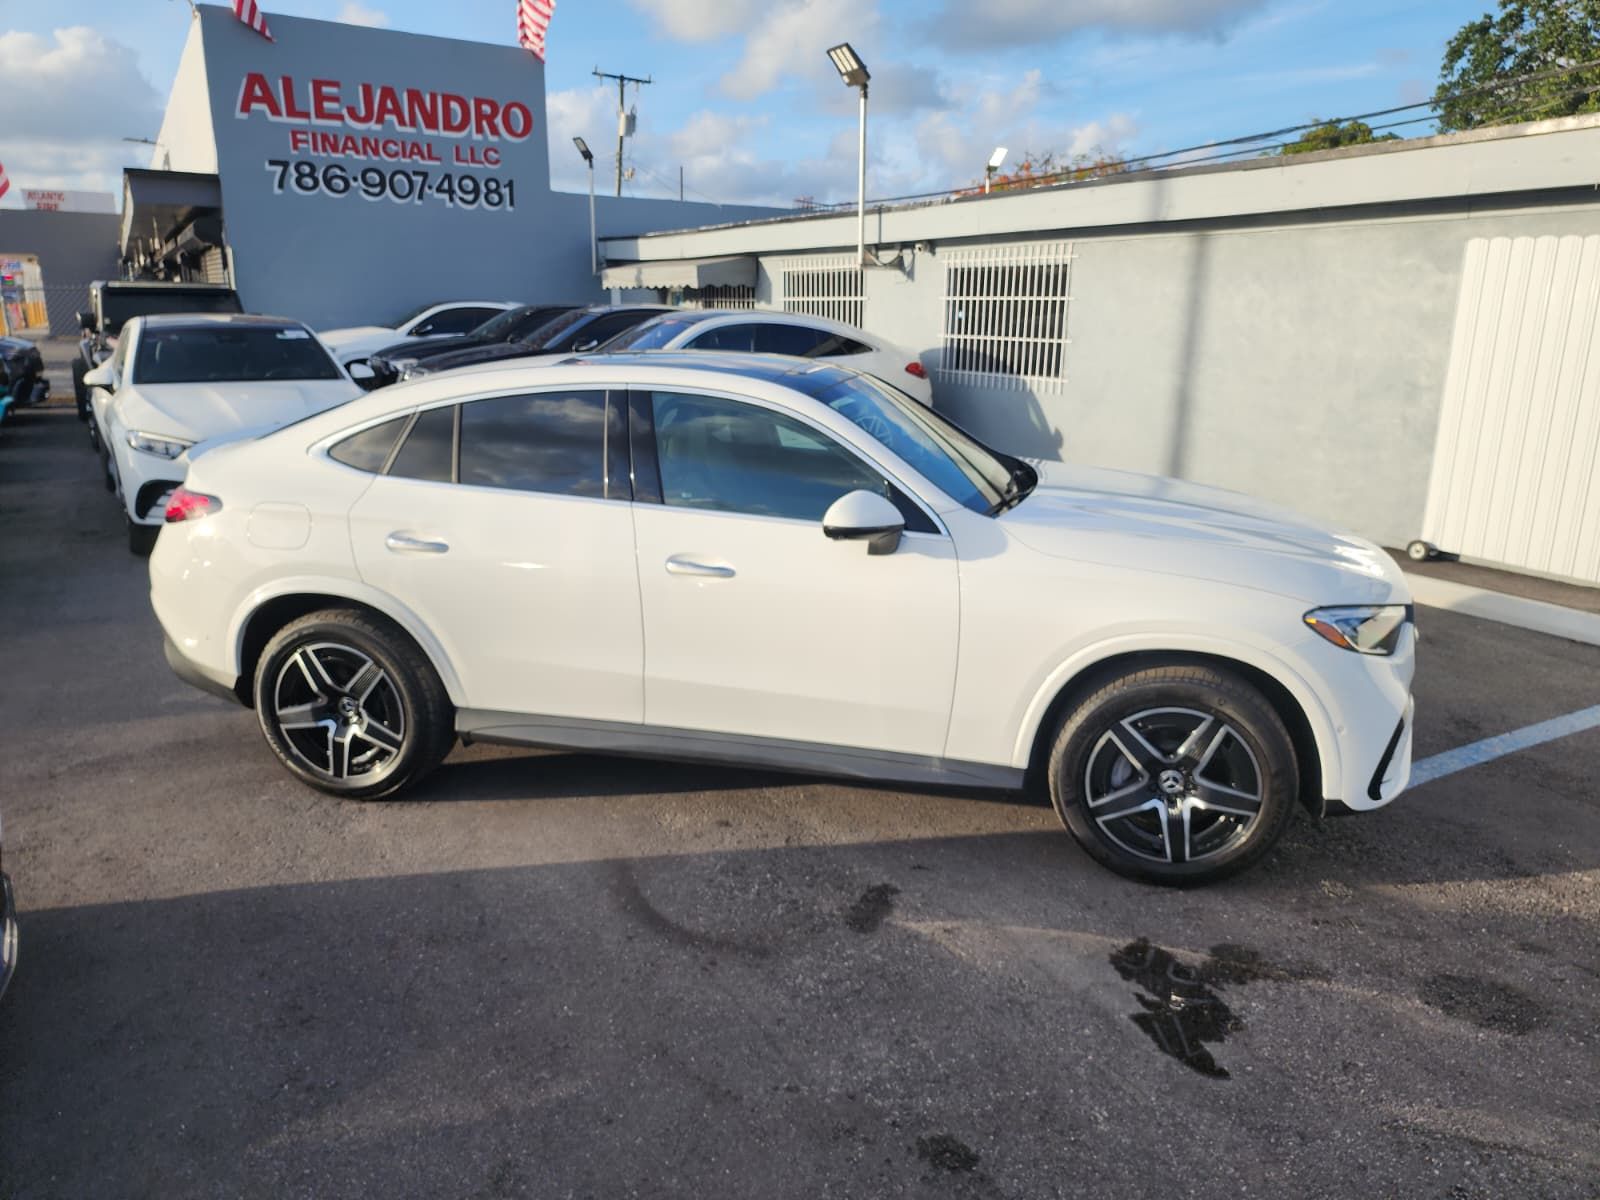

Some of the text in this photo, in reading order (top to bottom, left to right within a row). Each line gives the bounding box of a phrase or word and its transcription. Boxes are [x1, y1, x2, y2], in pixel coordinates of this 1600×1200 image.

[235, 72, 533, 142] ALEJANDRO
[289, 130, 502, 168] FINANCIAL LLC
